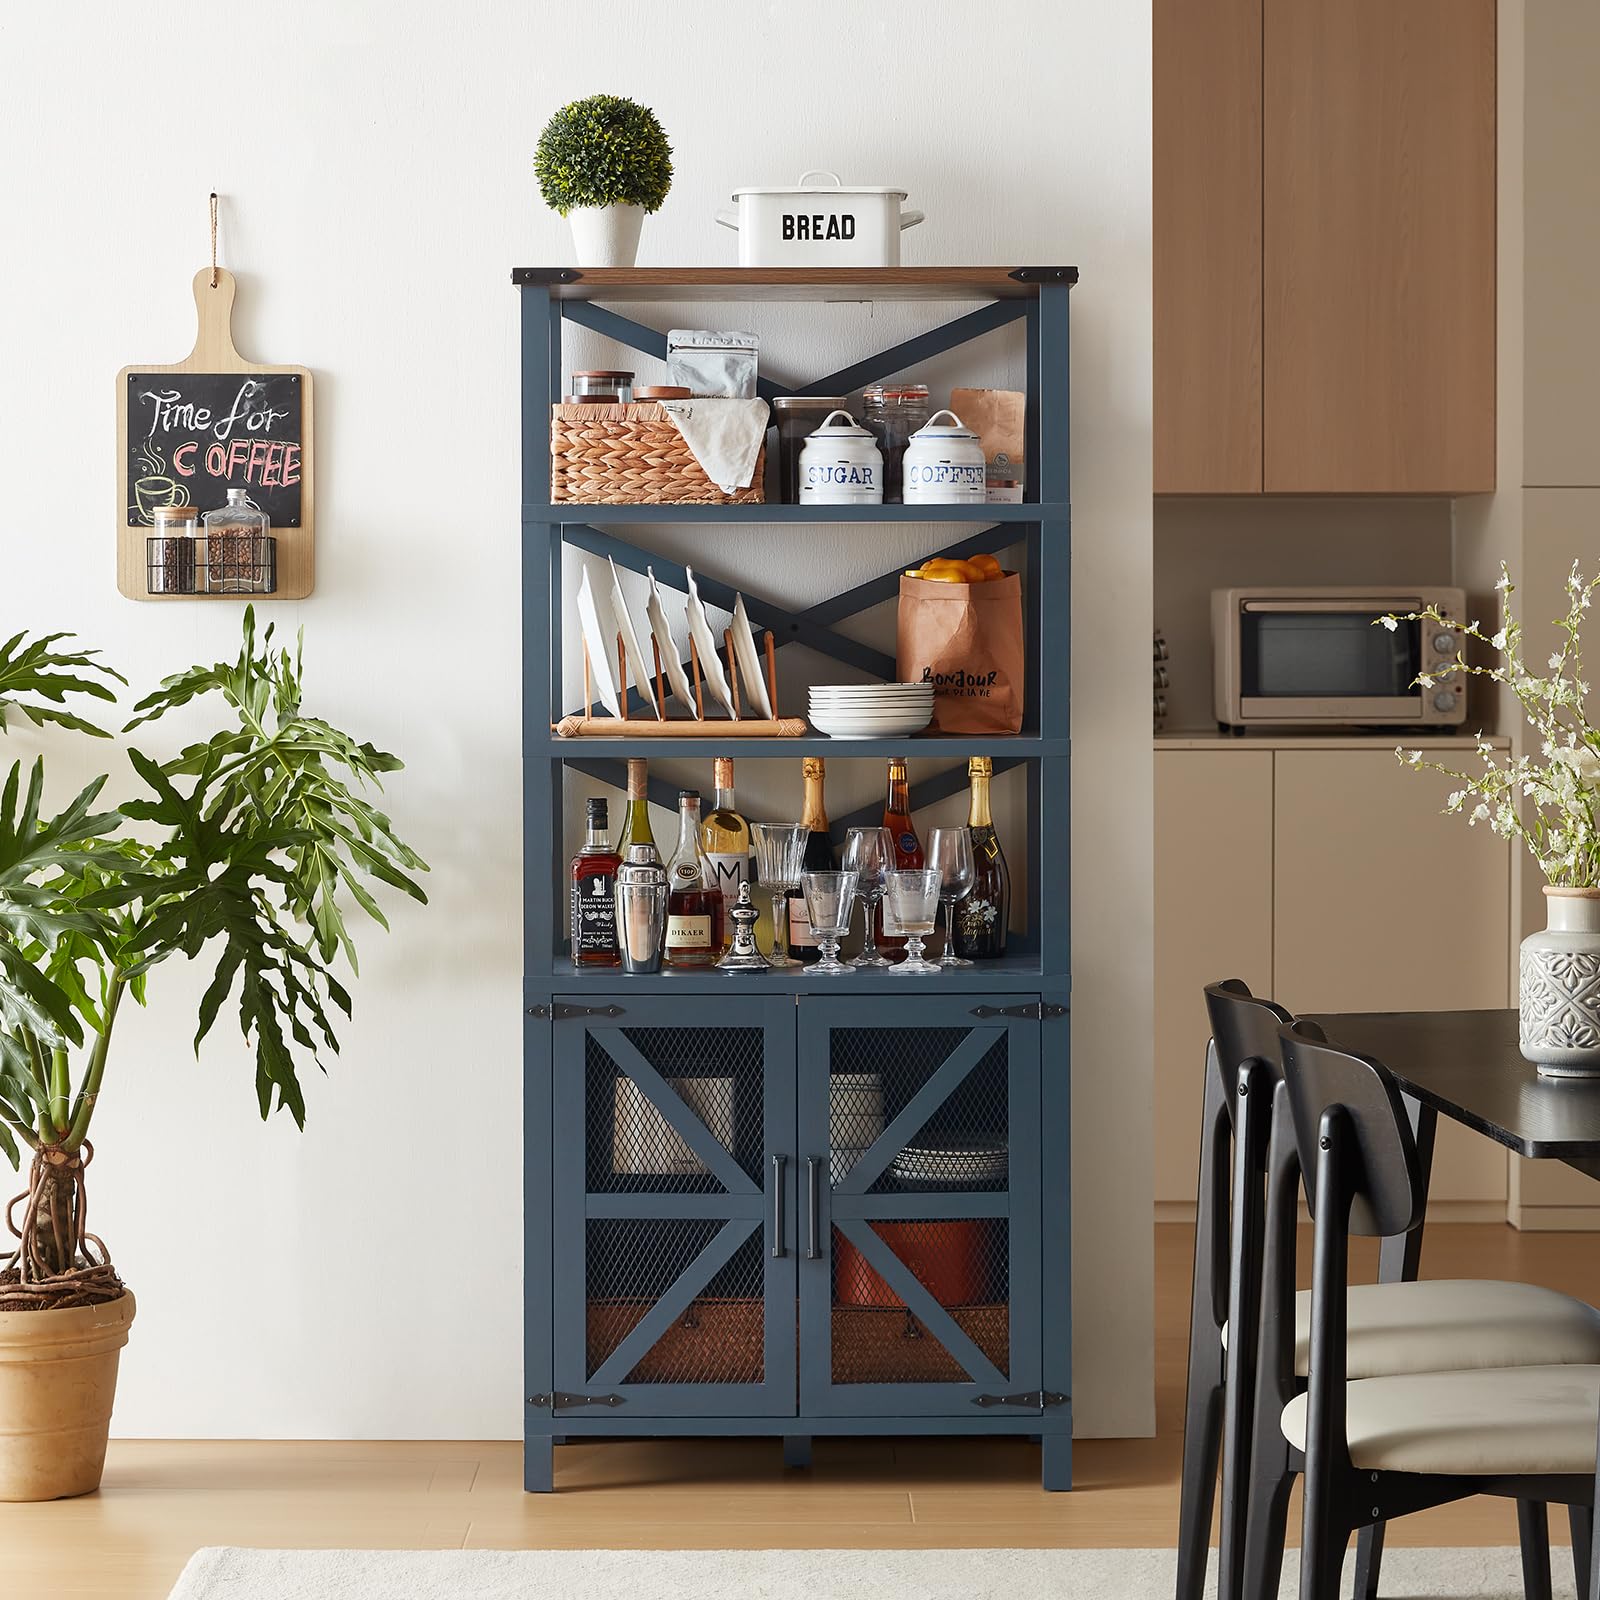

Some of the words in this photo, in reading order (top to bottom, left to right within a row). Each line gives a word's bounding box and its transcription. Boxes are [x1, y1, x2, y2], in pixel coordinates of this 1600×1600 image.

[782, 214, 856, 240] BREAD
[139, 389, 212, 438] Time
[213, 379, 289, 440] for
[808, 466, 873, 484] SUGAR
[909, 465, 984, 484] COFFEE
[717, 861, 740, 884] M
